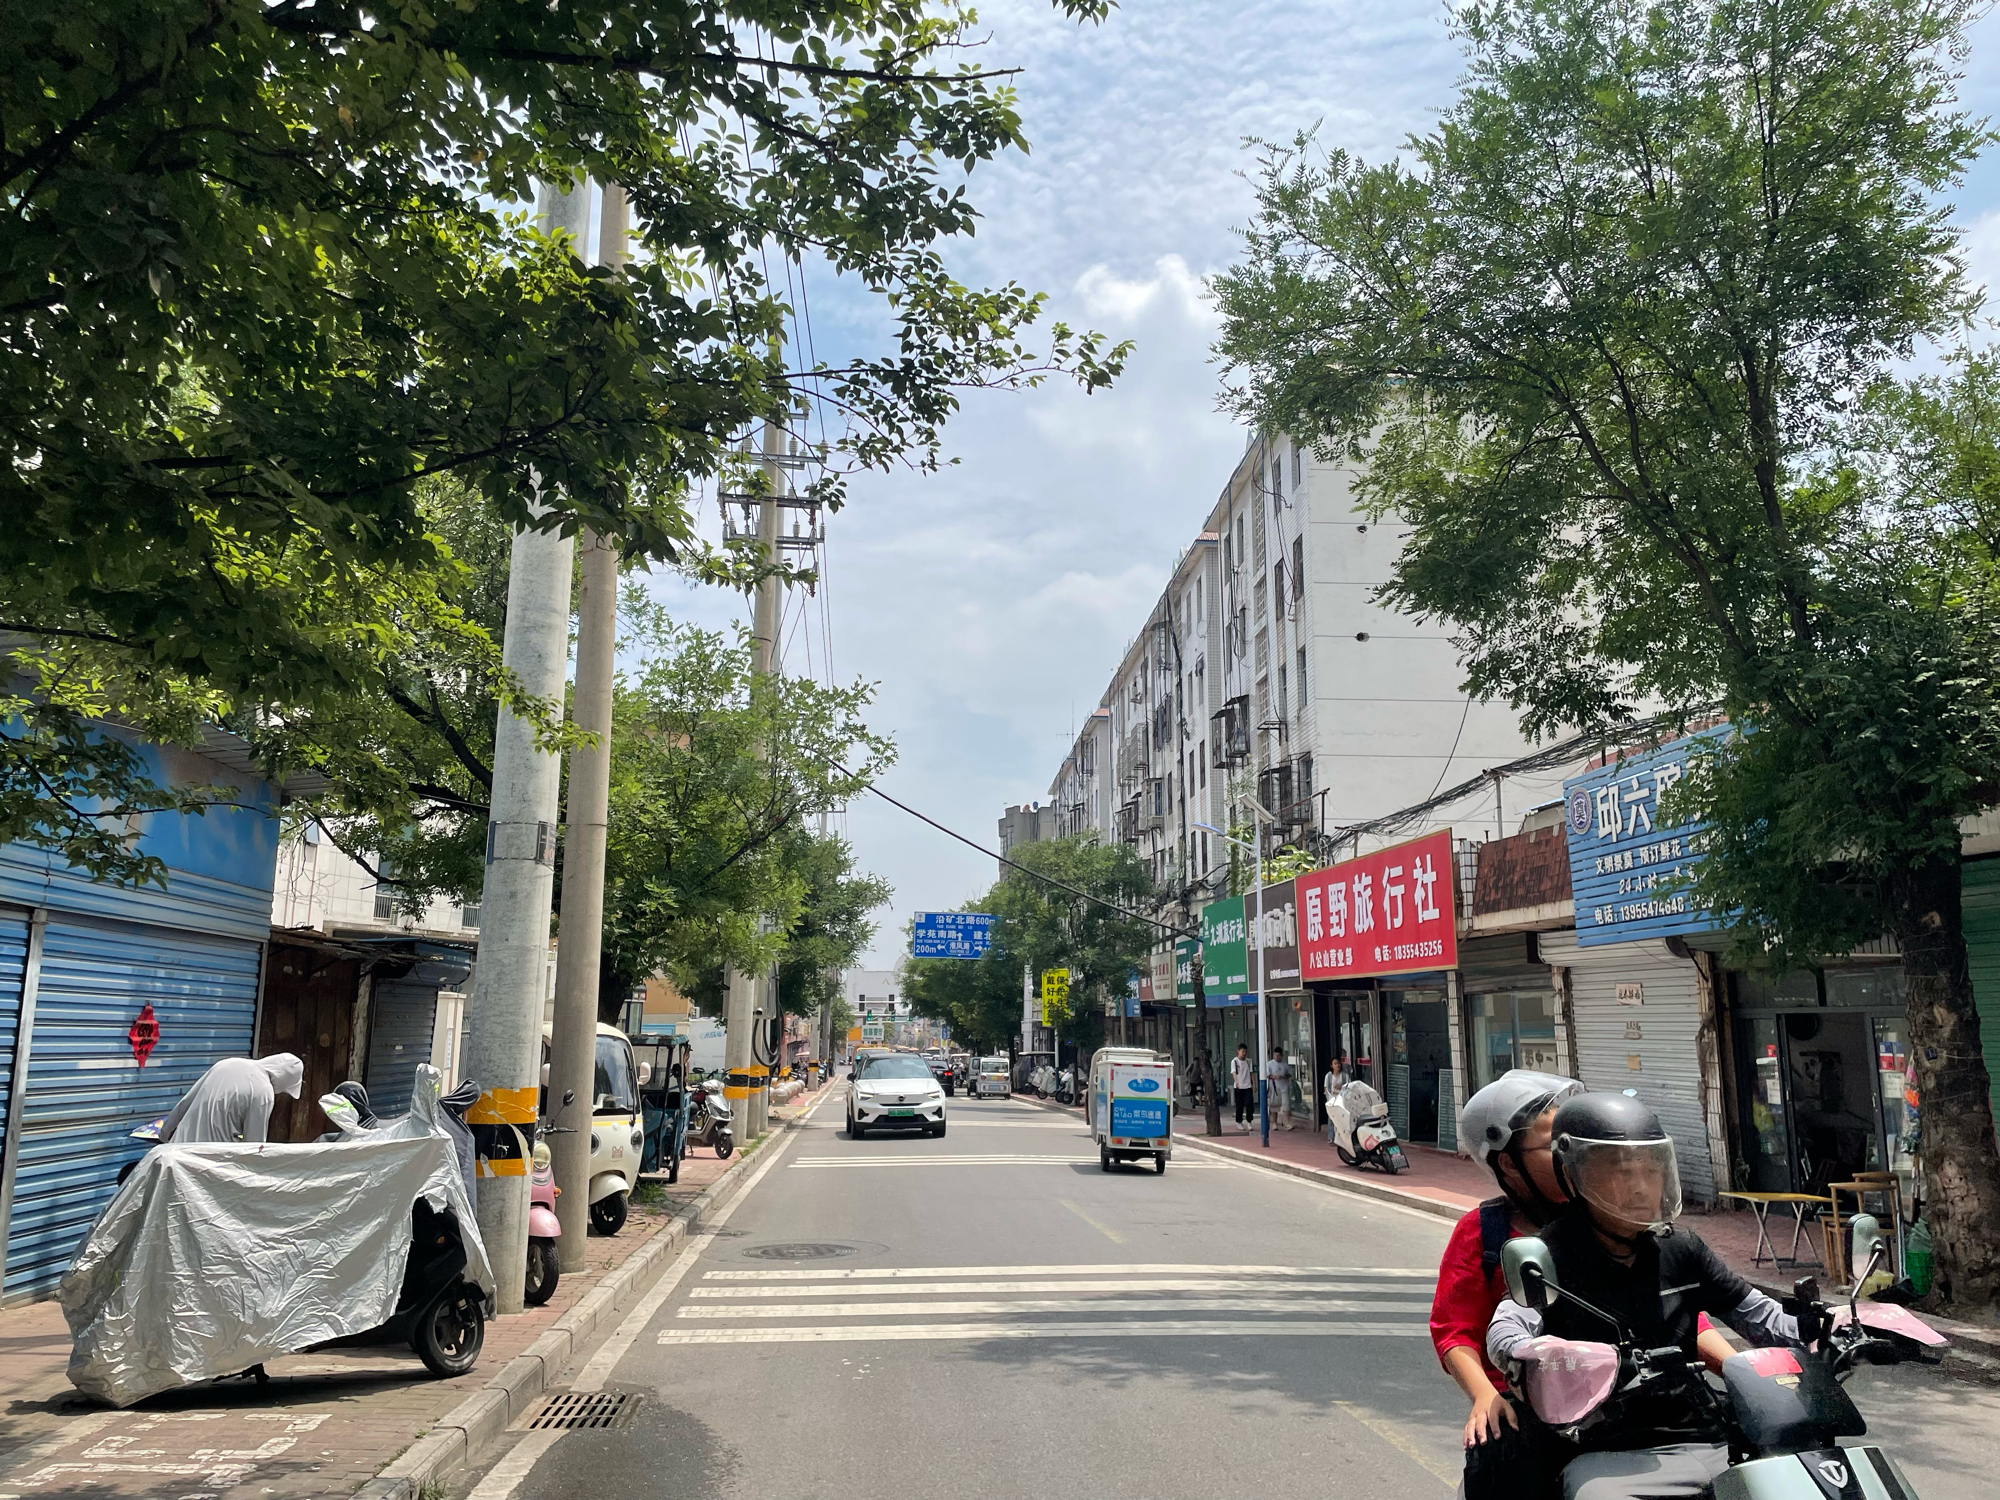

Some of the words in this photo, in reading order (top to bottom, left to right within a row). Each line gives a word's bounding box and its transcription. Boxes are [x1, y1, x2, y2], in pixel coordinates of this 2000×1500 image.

[1595, 850, 1634, 875] 文明祭奠
[1639, 838, 1682, 865] 预订鲜花
[1305, 853, 1440, 943] 原野旅行社
[935, 915, 975, 925] 沿矿北路
[916, 928, 957, 939] 学苑南路
[915, 944, 937, 954] 200m
[1309, 947, 1353, 969] 八公山营业部
